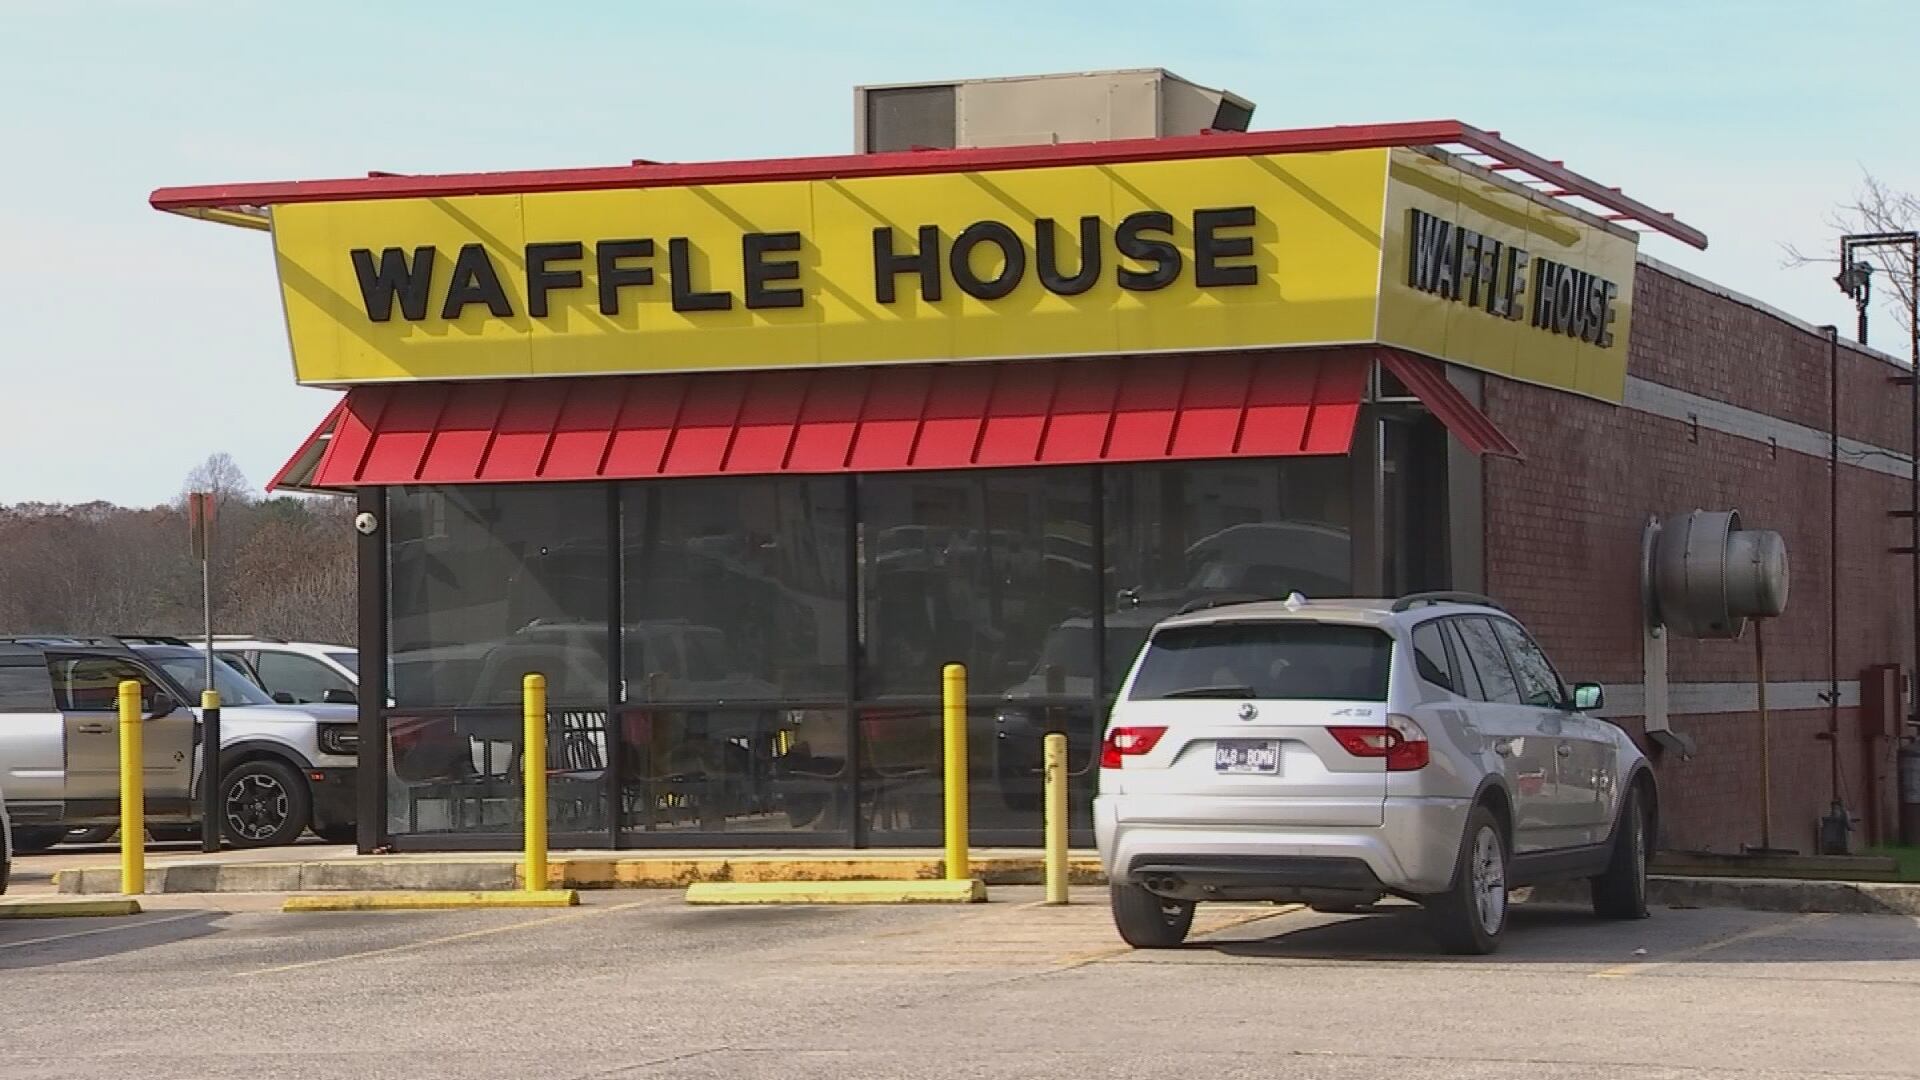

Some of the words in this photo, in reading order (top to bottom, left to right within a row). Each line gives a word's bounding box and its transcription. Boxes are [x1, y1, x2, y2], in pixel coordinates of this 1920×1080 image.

[350, 231, 804, 322] WAFFLE
[872, 206, 1258, 304] HOUSE
[1408, 208, 1528, 321] WAFFLE
[1531, 257, 1617, 349] HOUSE
